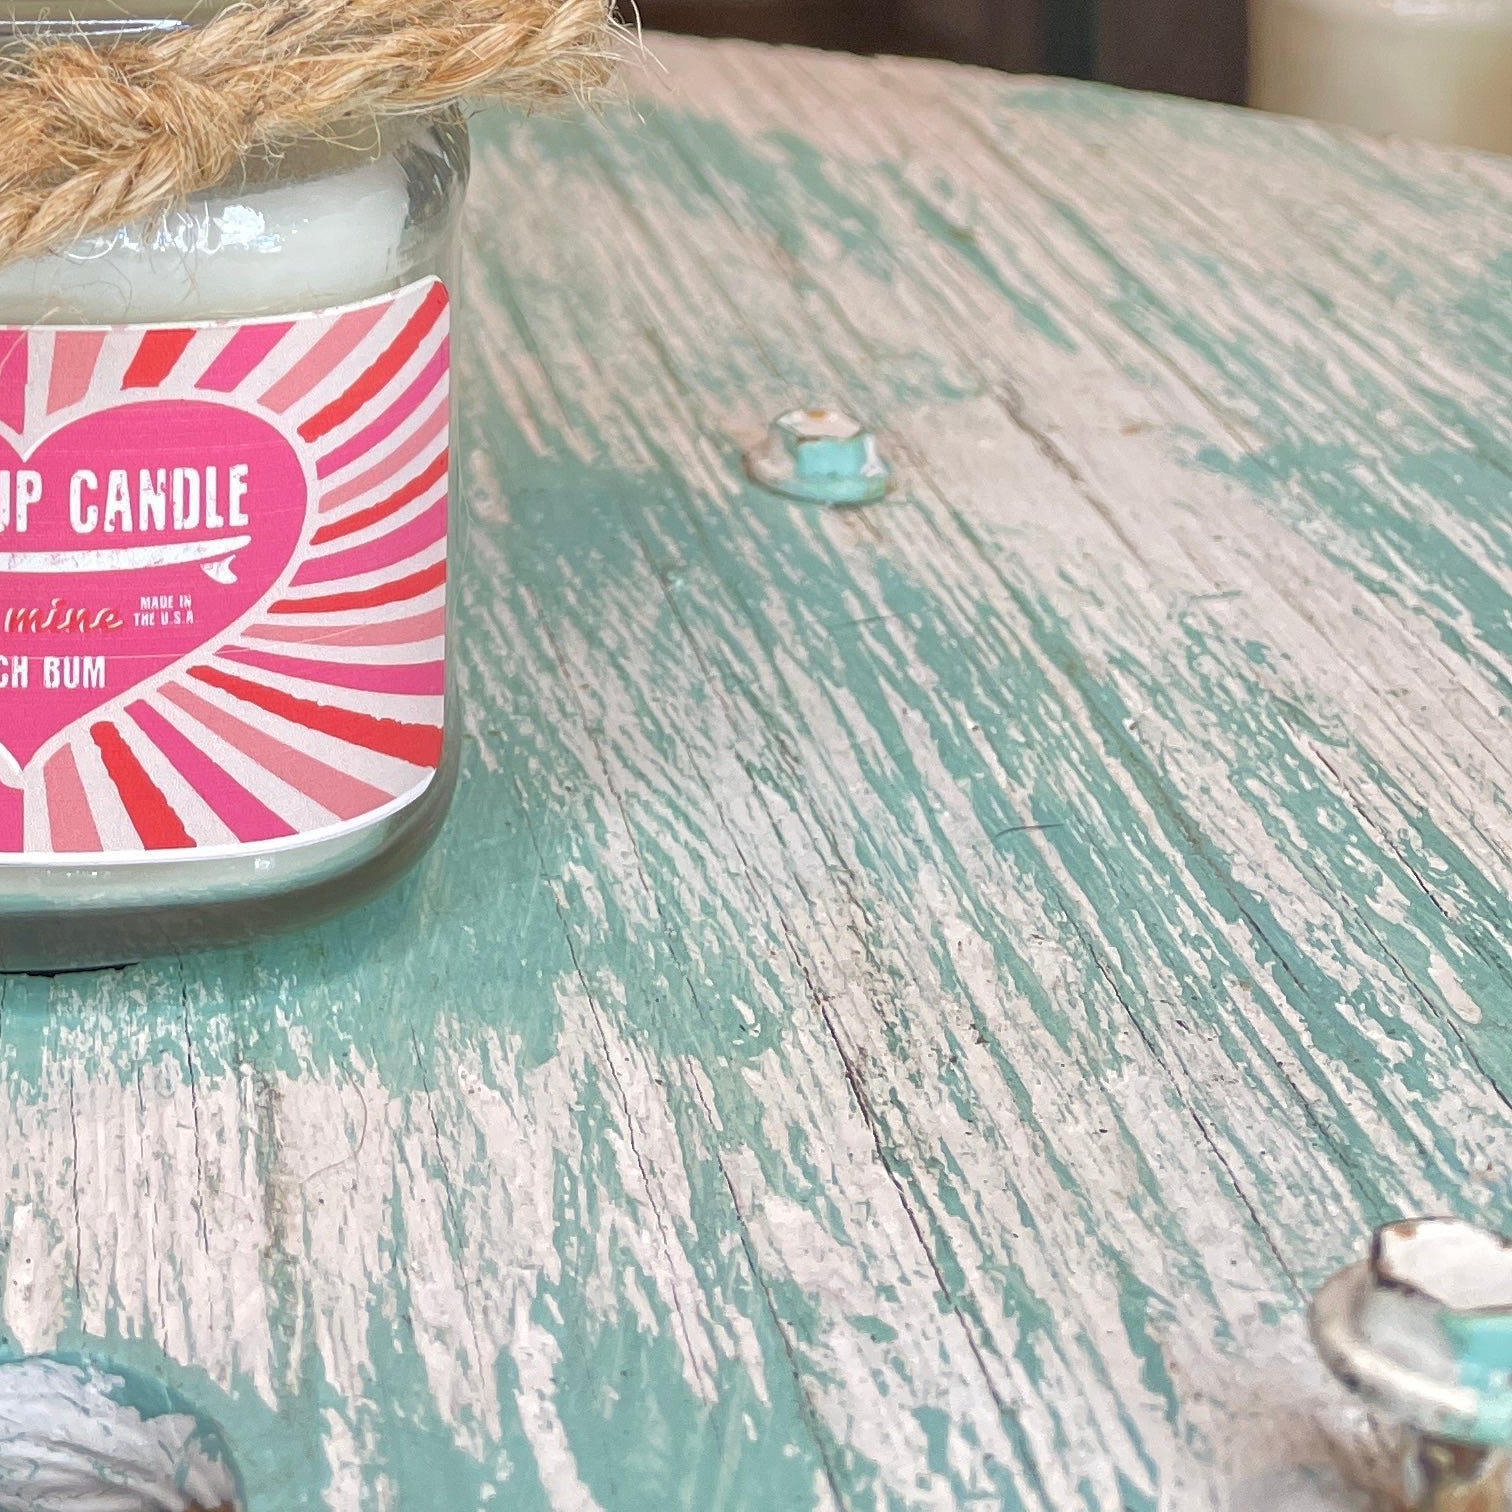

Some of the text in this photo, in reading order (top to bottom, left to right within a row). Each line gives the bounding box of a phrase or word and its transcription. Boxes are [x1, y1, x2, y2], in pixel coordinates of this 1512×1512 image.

[69, 464, 249, 533] CANDLE
[4, 598, 123, 633] mine
[140, 593, 192, 610] MADE IN
[133, 611, 155, 627] THE
[43, 656, 106, 688] BUM
